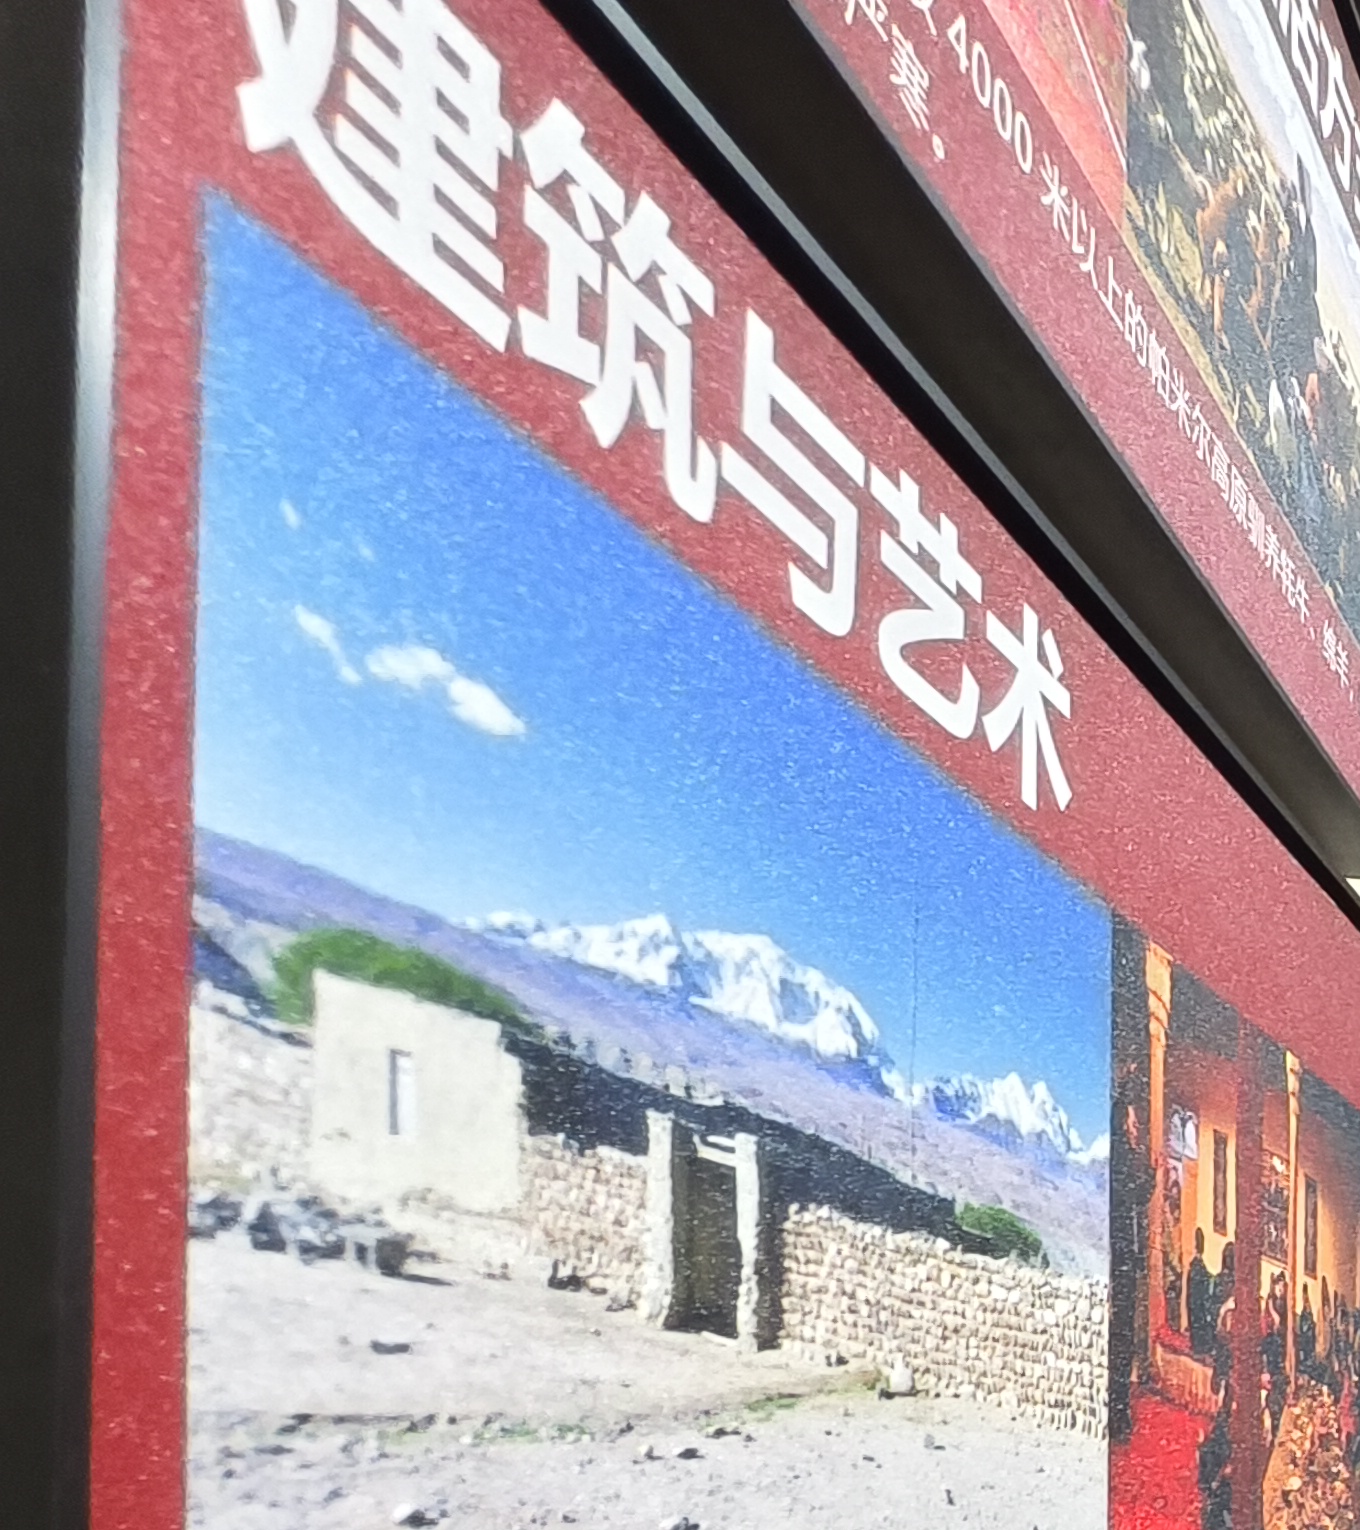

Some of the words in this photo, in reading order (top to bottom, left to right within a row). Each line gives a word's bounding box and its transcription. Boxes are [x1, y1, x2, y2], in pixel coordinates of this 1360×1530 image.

[236, 0, 1073, 812] 建筑与艺术
